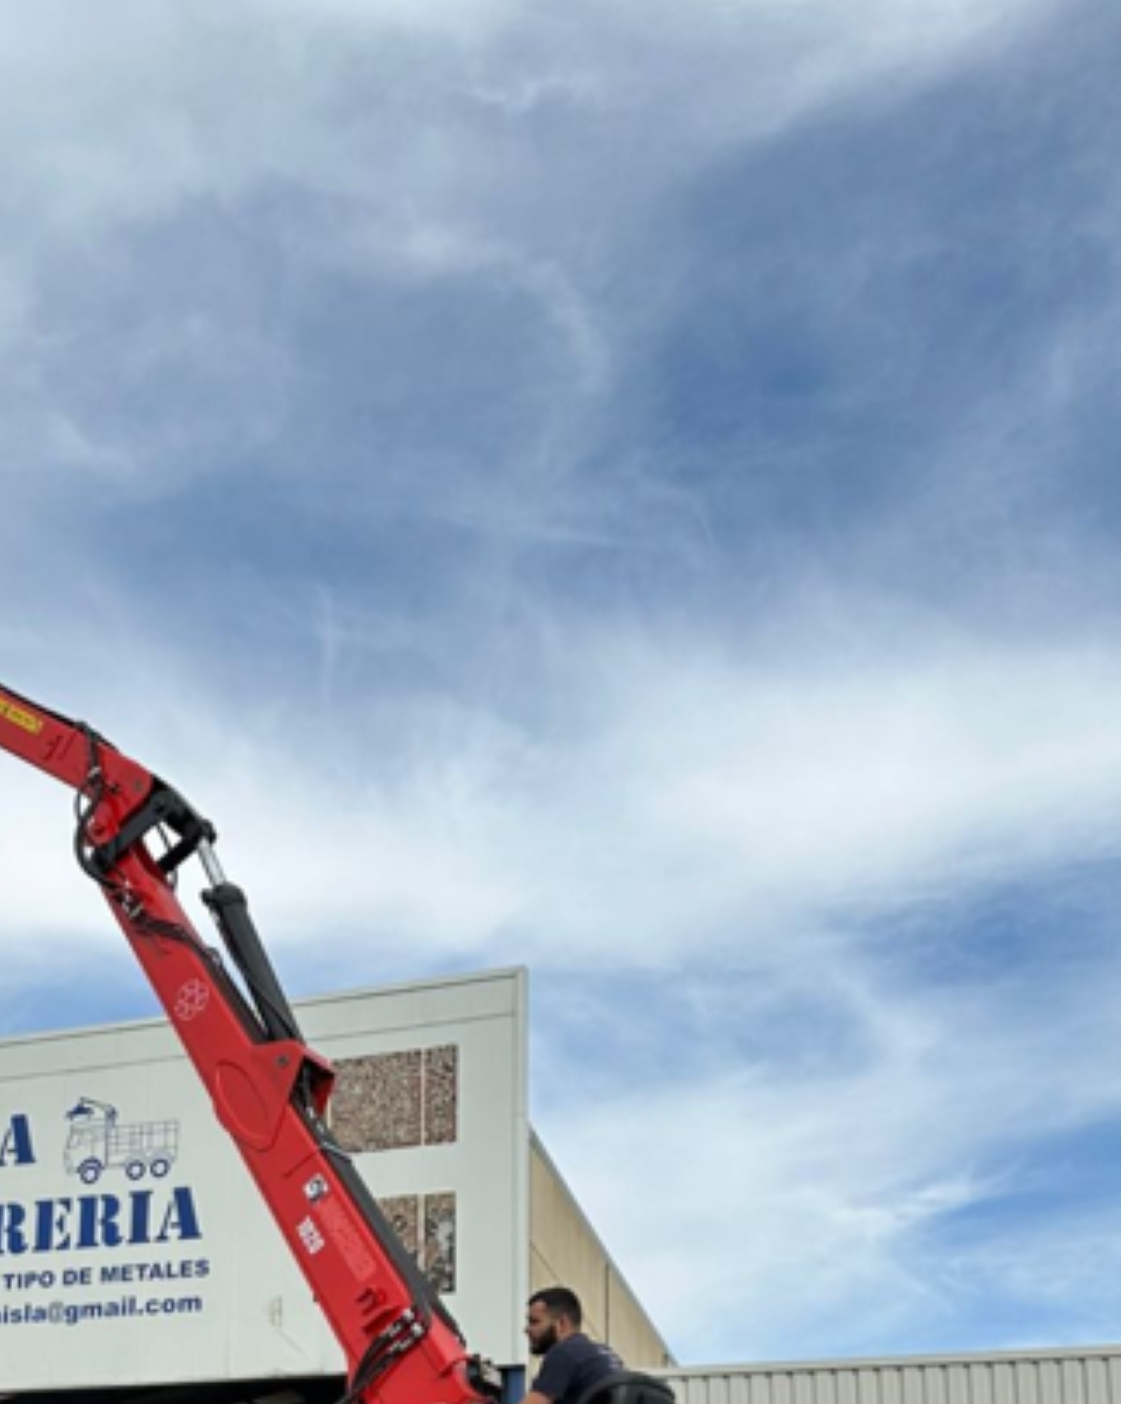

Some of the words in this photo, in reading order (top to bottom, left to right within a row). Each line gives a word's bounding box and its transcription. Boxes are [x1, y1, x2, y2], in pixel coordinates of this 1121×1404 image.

[2, 1269, 56, 1290] TIPO
[62, 1266, 93, 1286] DE
[100, 1258, 211, 1283] METALES
